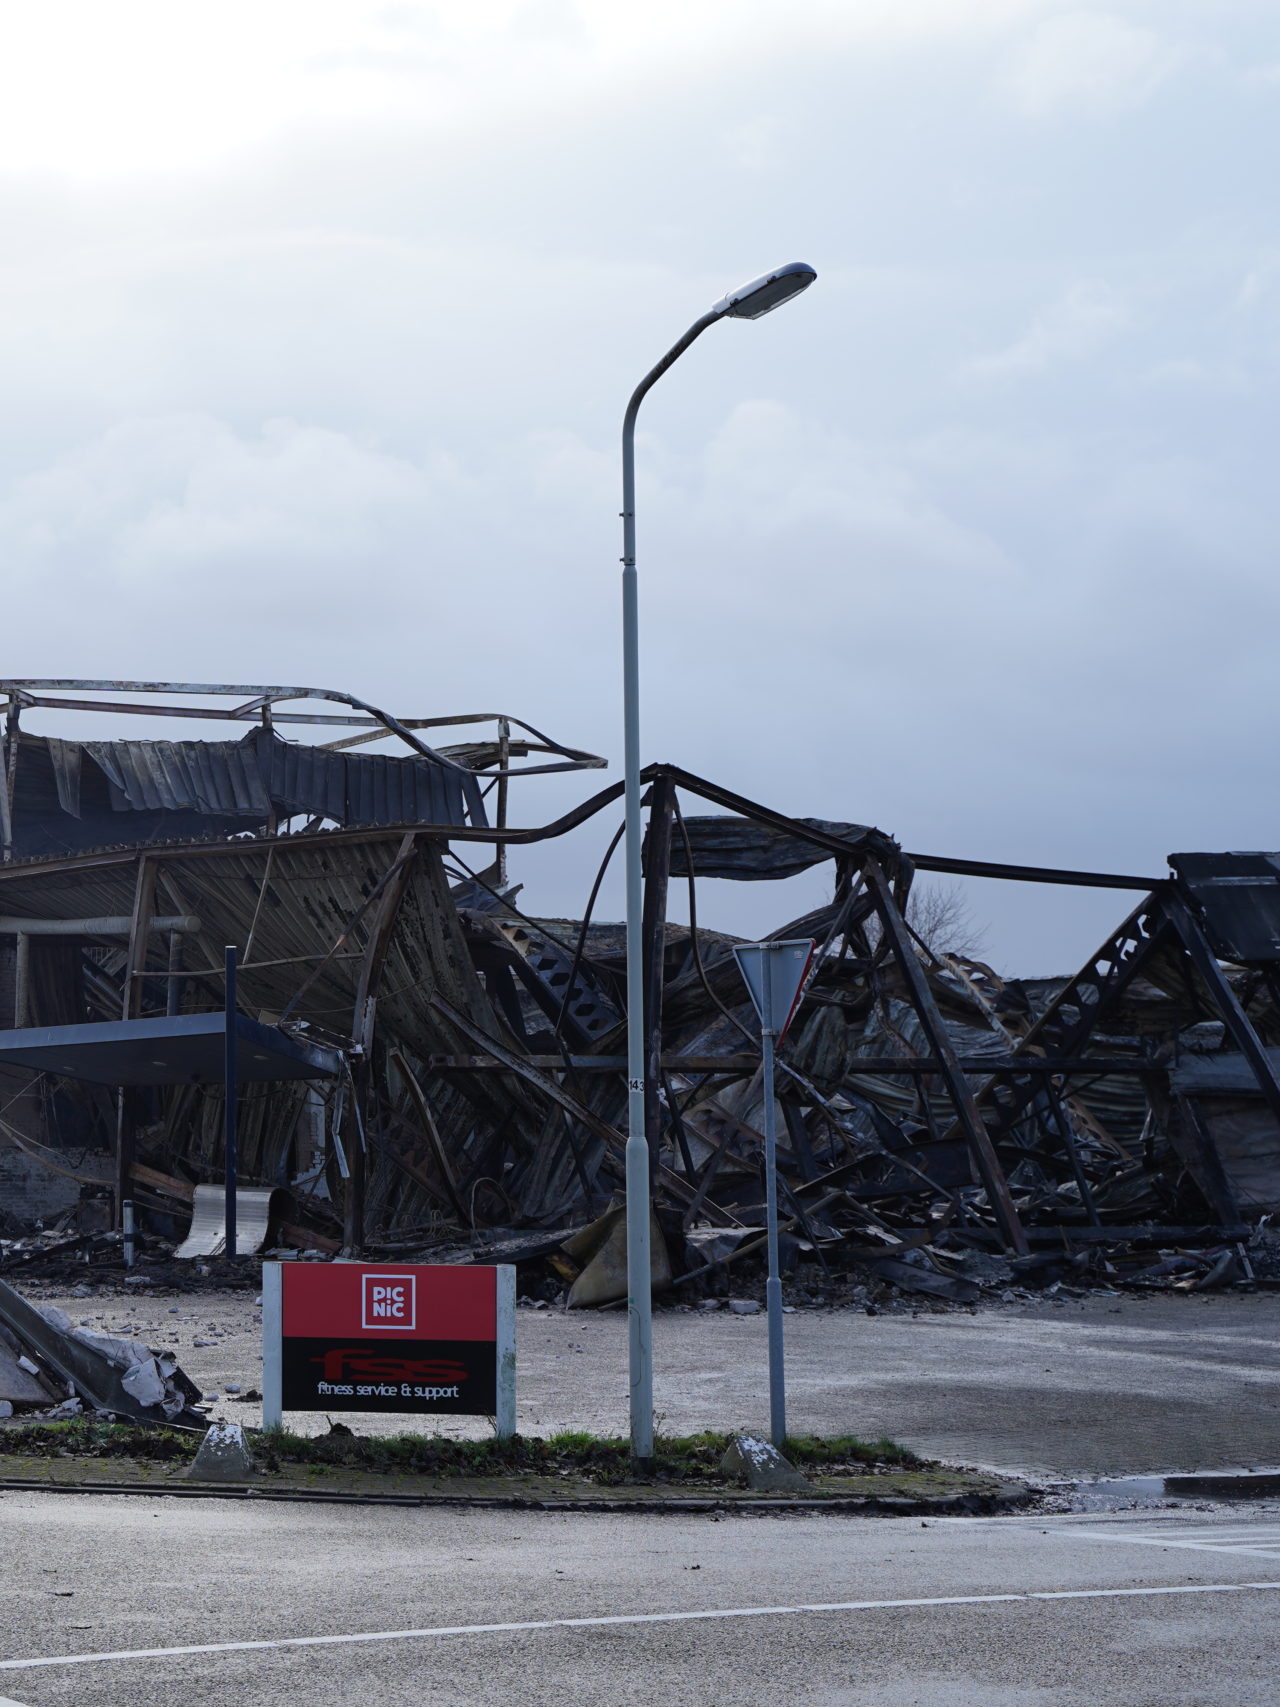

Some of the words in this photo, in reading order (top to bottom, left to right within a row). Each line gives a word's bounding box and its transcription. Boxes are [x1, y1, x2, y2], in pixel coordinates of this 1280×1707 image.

[372, 1286, 405, 1302] PIC
[317, 1381, 354, 1395] fitness
[356, 1382, 398, 1396] service
[400, 1383, 412, 1397] &
[414, 1385, 460, 1401] support
